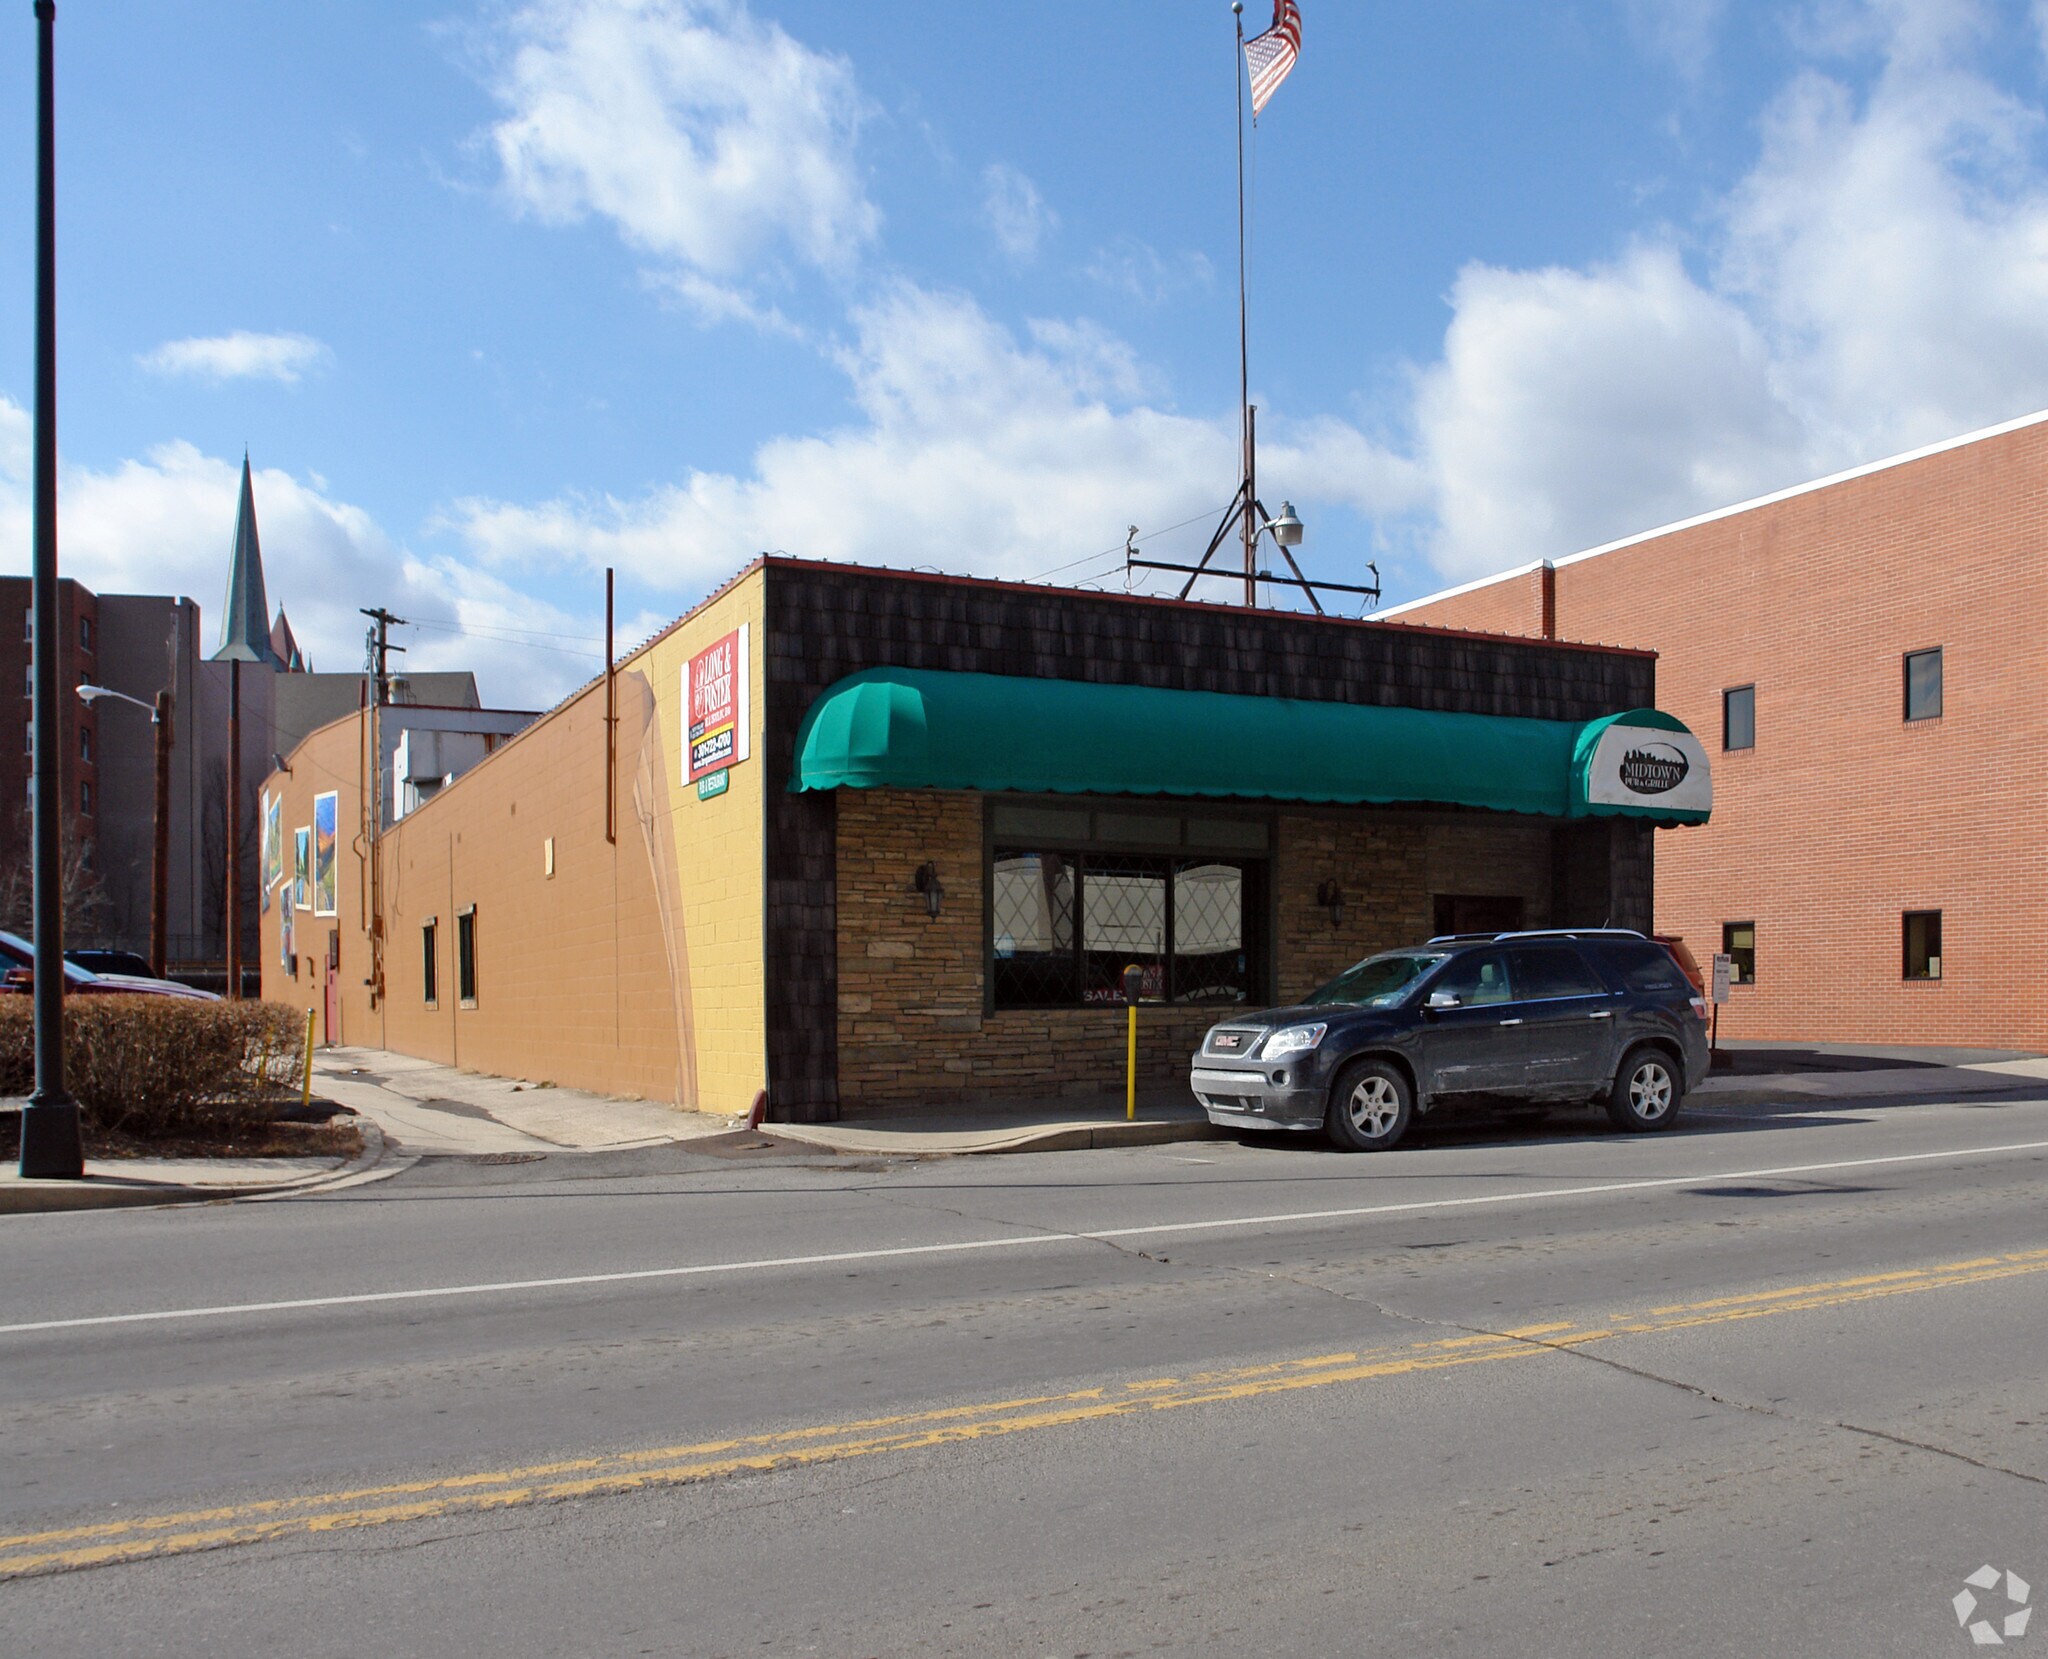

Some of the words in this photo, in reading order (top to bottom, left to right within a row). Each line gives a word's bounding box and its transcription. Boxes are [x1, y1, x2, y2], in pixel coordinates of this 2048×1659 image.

[704, 646, 723, 685] LONG
[724, 642, 731, 674] &
[704, 672, 731, 715] FOSTER
[1625, 762, 1681, 780] MIDTOWN
[1083, 990, 1122, 1001] SALE
[1215, 1035, 1240, 1047] GMC
